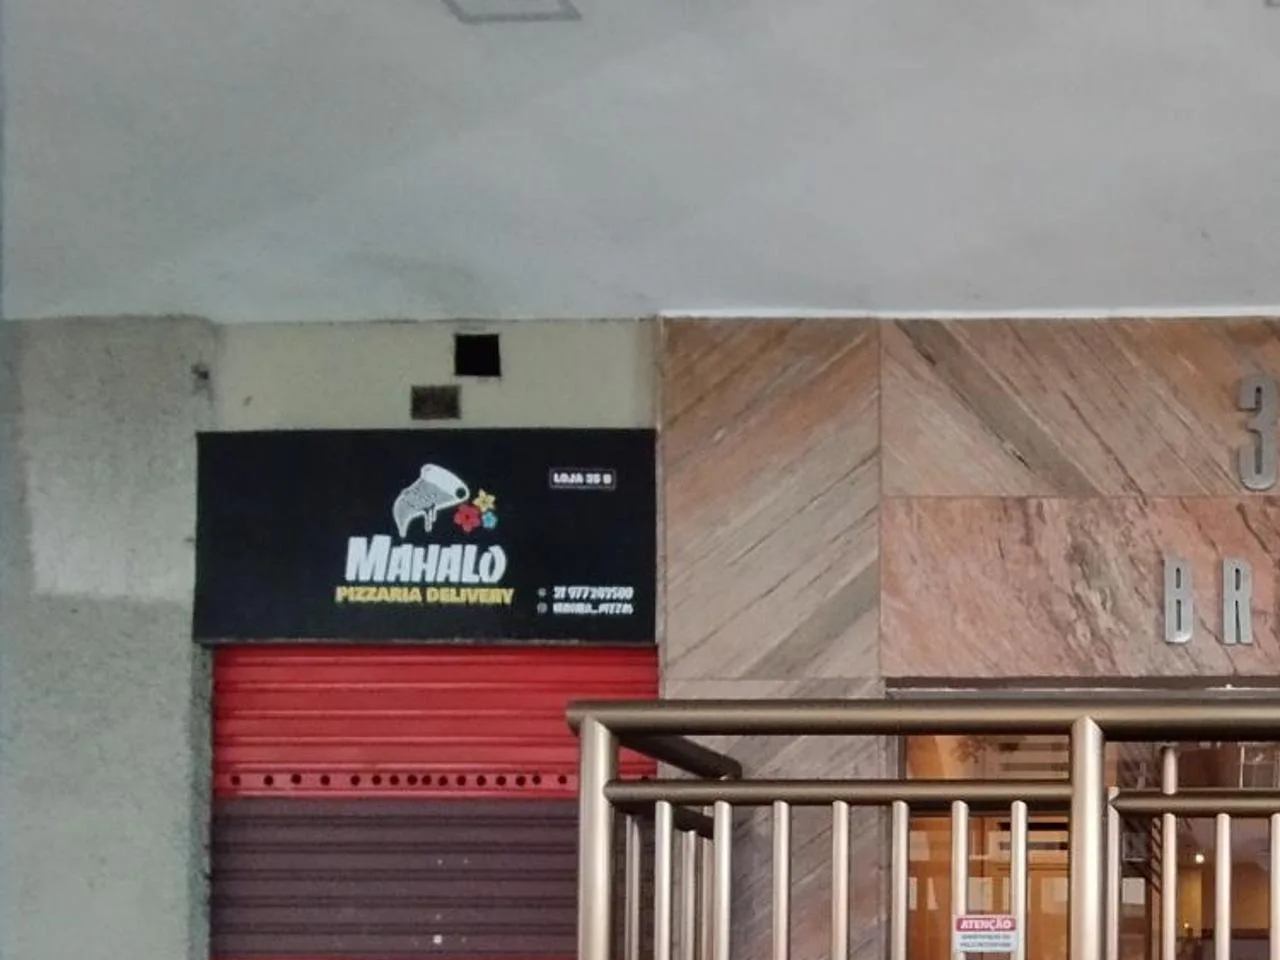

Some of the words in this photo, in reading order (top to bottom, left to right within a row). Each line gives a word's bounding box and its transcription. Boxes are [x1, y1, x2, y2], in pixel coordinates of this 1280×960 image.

[345, 534, 507, 583] MAHALO
[335, 586, 423, 602] PIZZARIA
[426, 587, 515, 604] DELIVERY
